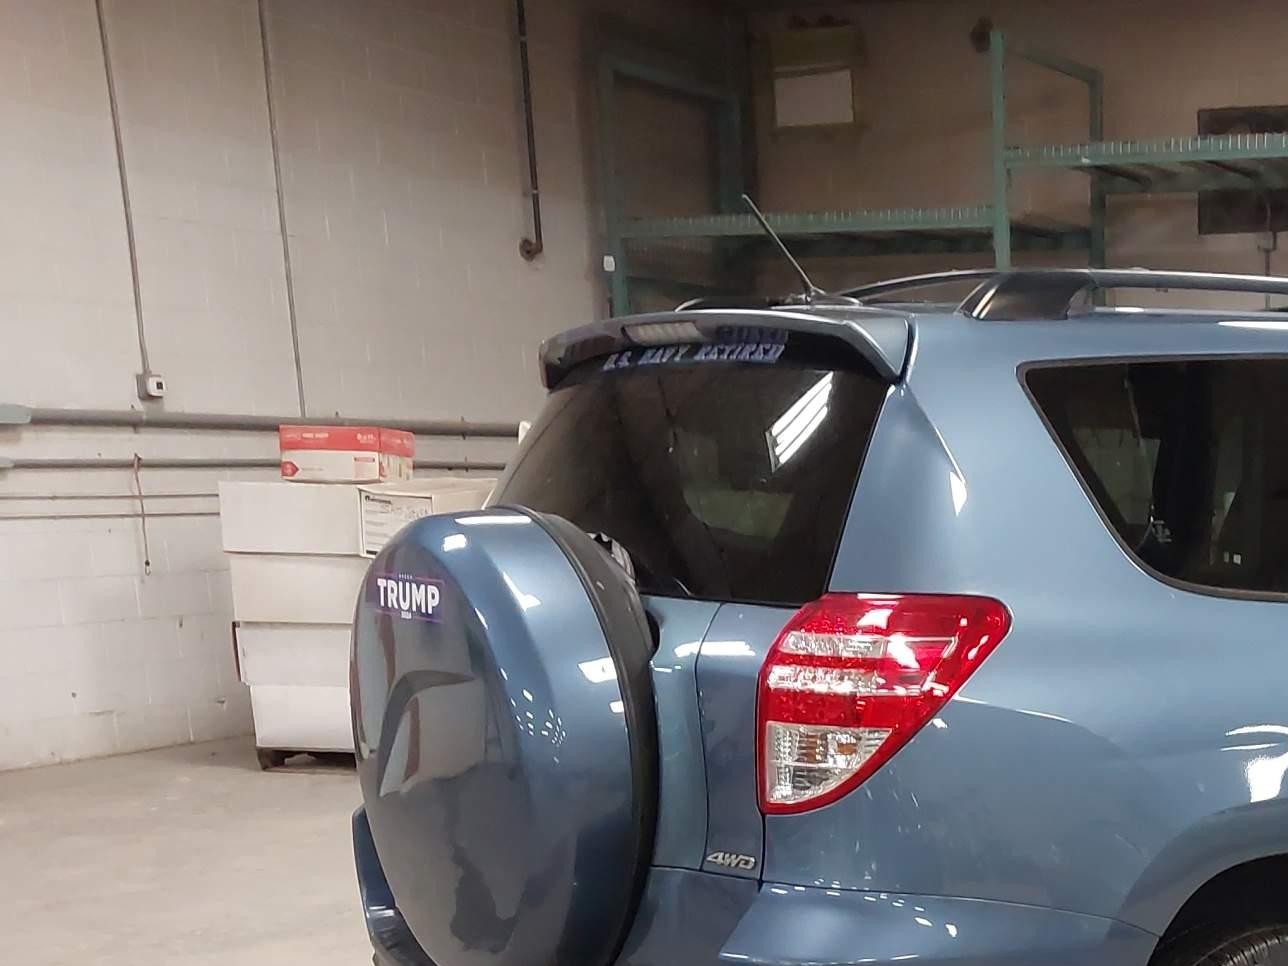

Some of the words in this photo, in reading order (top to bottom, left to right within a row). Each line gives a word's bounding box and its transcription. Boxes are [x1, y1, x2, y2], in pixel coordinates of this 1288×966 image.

[693, 342, 786, 362] RETIRED
[377, 578, 440, 614] TRUMP
[706, 851, 756, 870] 4WD
